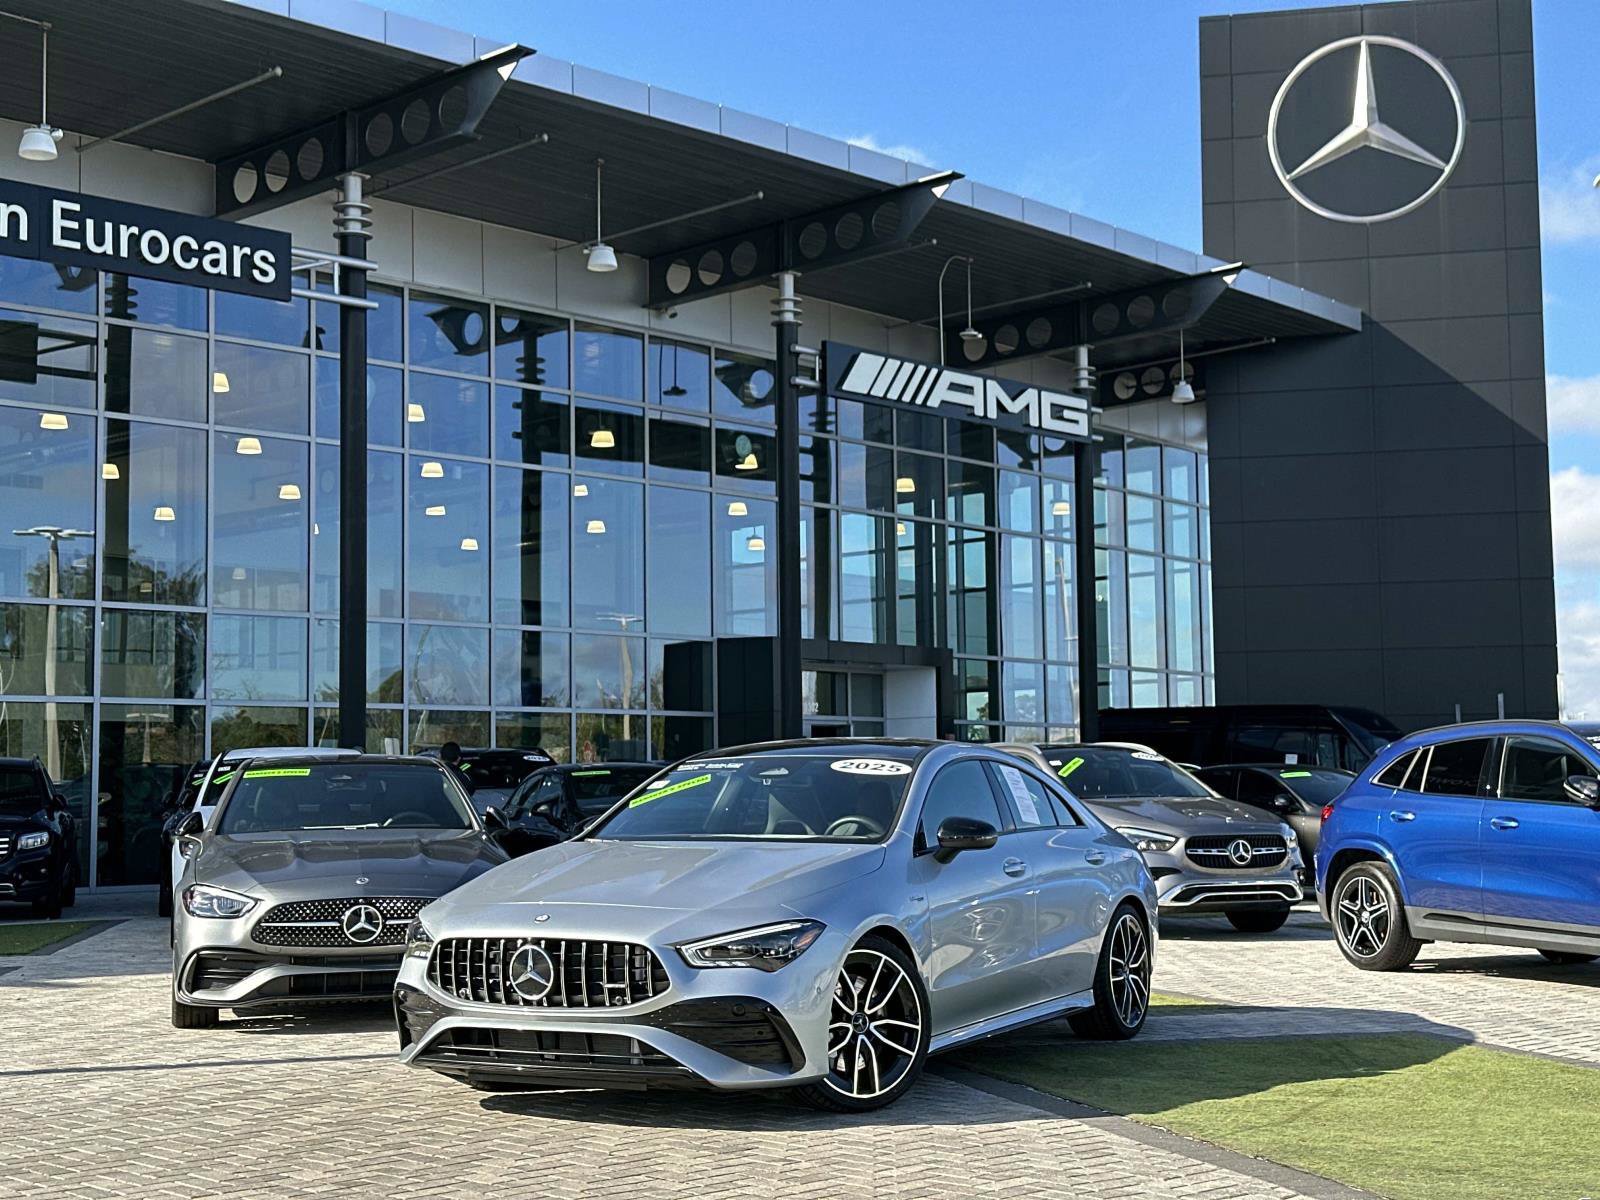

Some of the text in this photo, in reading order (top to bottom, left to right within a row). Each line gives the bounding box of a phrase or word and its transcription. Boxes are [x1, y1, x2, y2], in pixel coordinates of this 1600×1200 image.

[52, 199, 276, 284] Eurocars
[927, 369, 1088, 437] AMG
[840, 761, 903, 772] 2025
